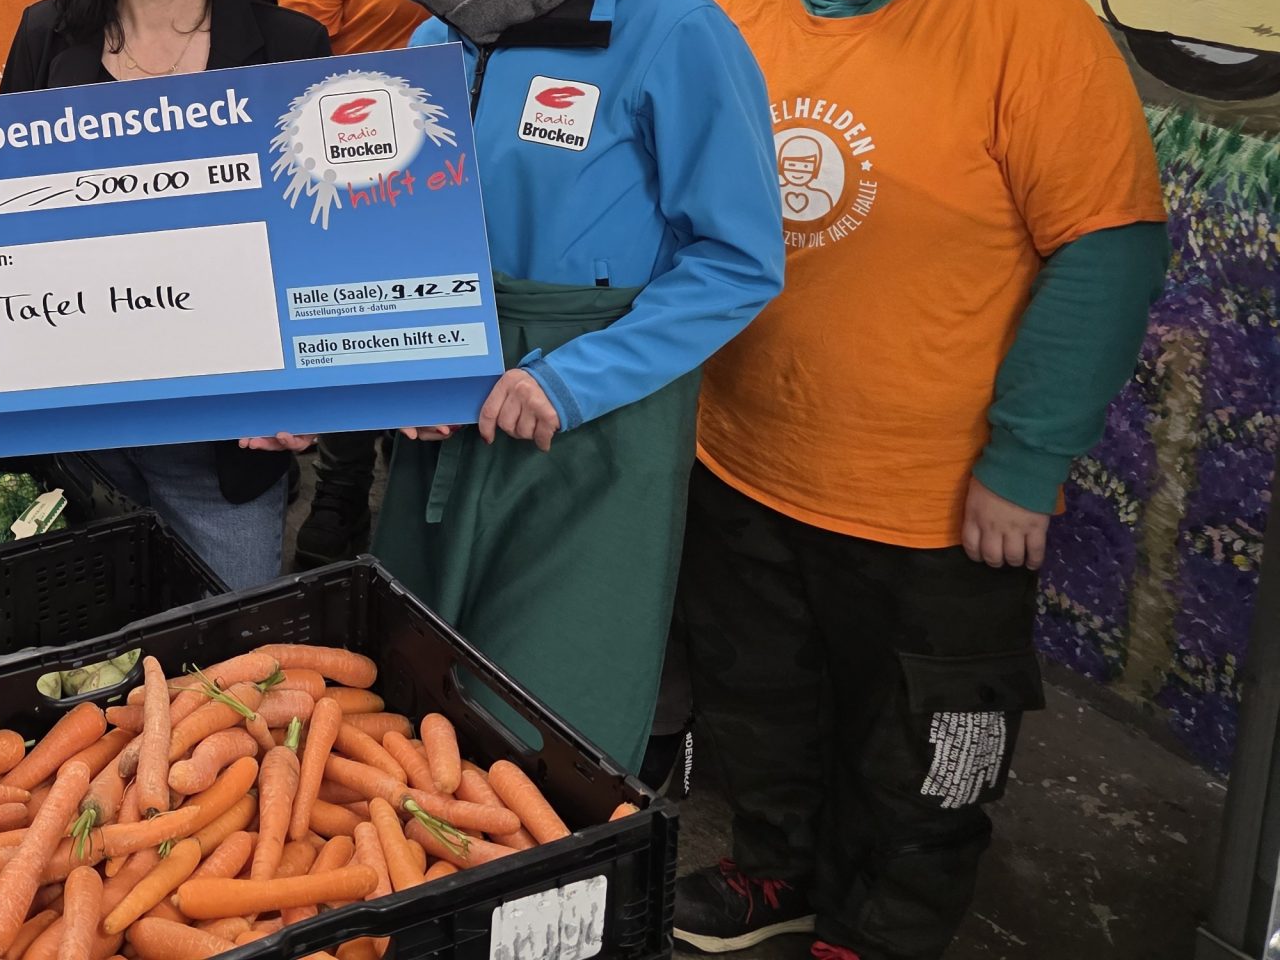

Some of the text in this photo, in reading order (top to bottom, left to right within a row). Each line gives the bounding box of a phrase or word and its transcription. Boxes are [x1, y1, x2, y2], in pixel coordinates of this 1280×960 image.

[535, 112, 575, 126] Radio
[338, 126, 377, 143] Radio
[523, 122, 586, 147] Brocken
[330, 142, 393, 159] Brocken
[75, 162, 251, 202] 500,00 EUR
[347, 152, 469, 208] hilft e.V.
[809, 230, 826, 248] DIE
[827, 213, 862, 242] TAFEL
[851, 179, 878, 216] HALLE
[109, 285, 195, 313] Halle
[293, 290, 329, 304] Halle
[334, 285, 388, 303] (Saale),
[295, 302, 397, 318] Ausstellungsort & -datum
[298, 330, 465, 354] Radio Brocken hilft e.V.
[300, 356, 334, 366] Spender
